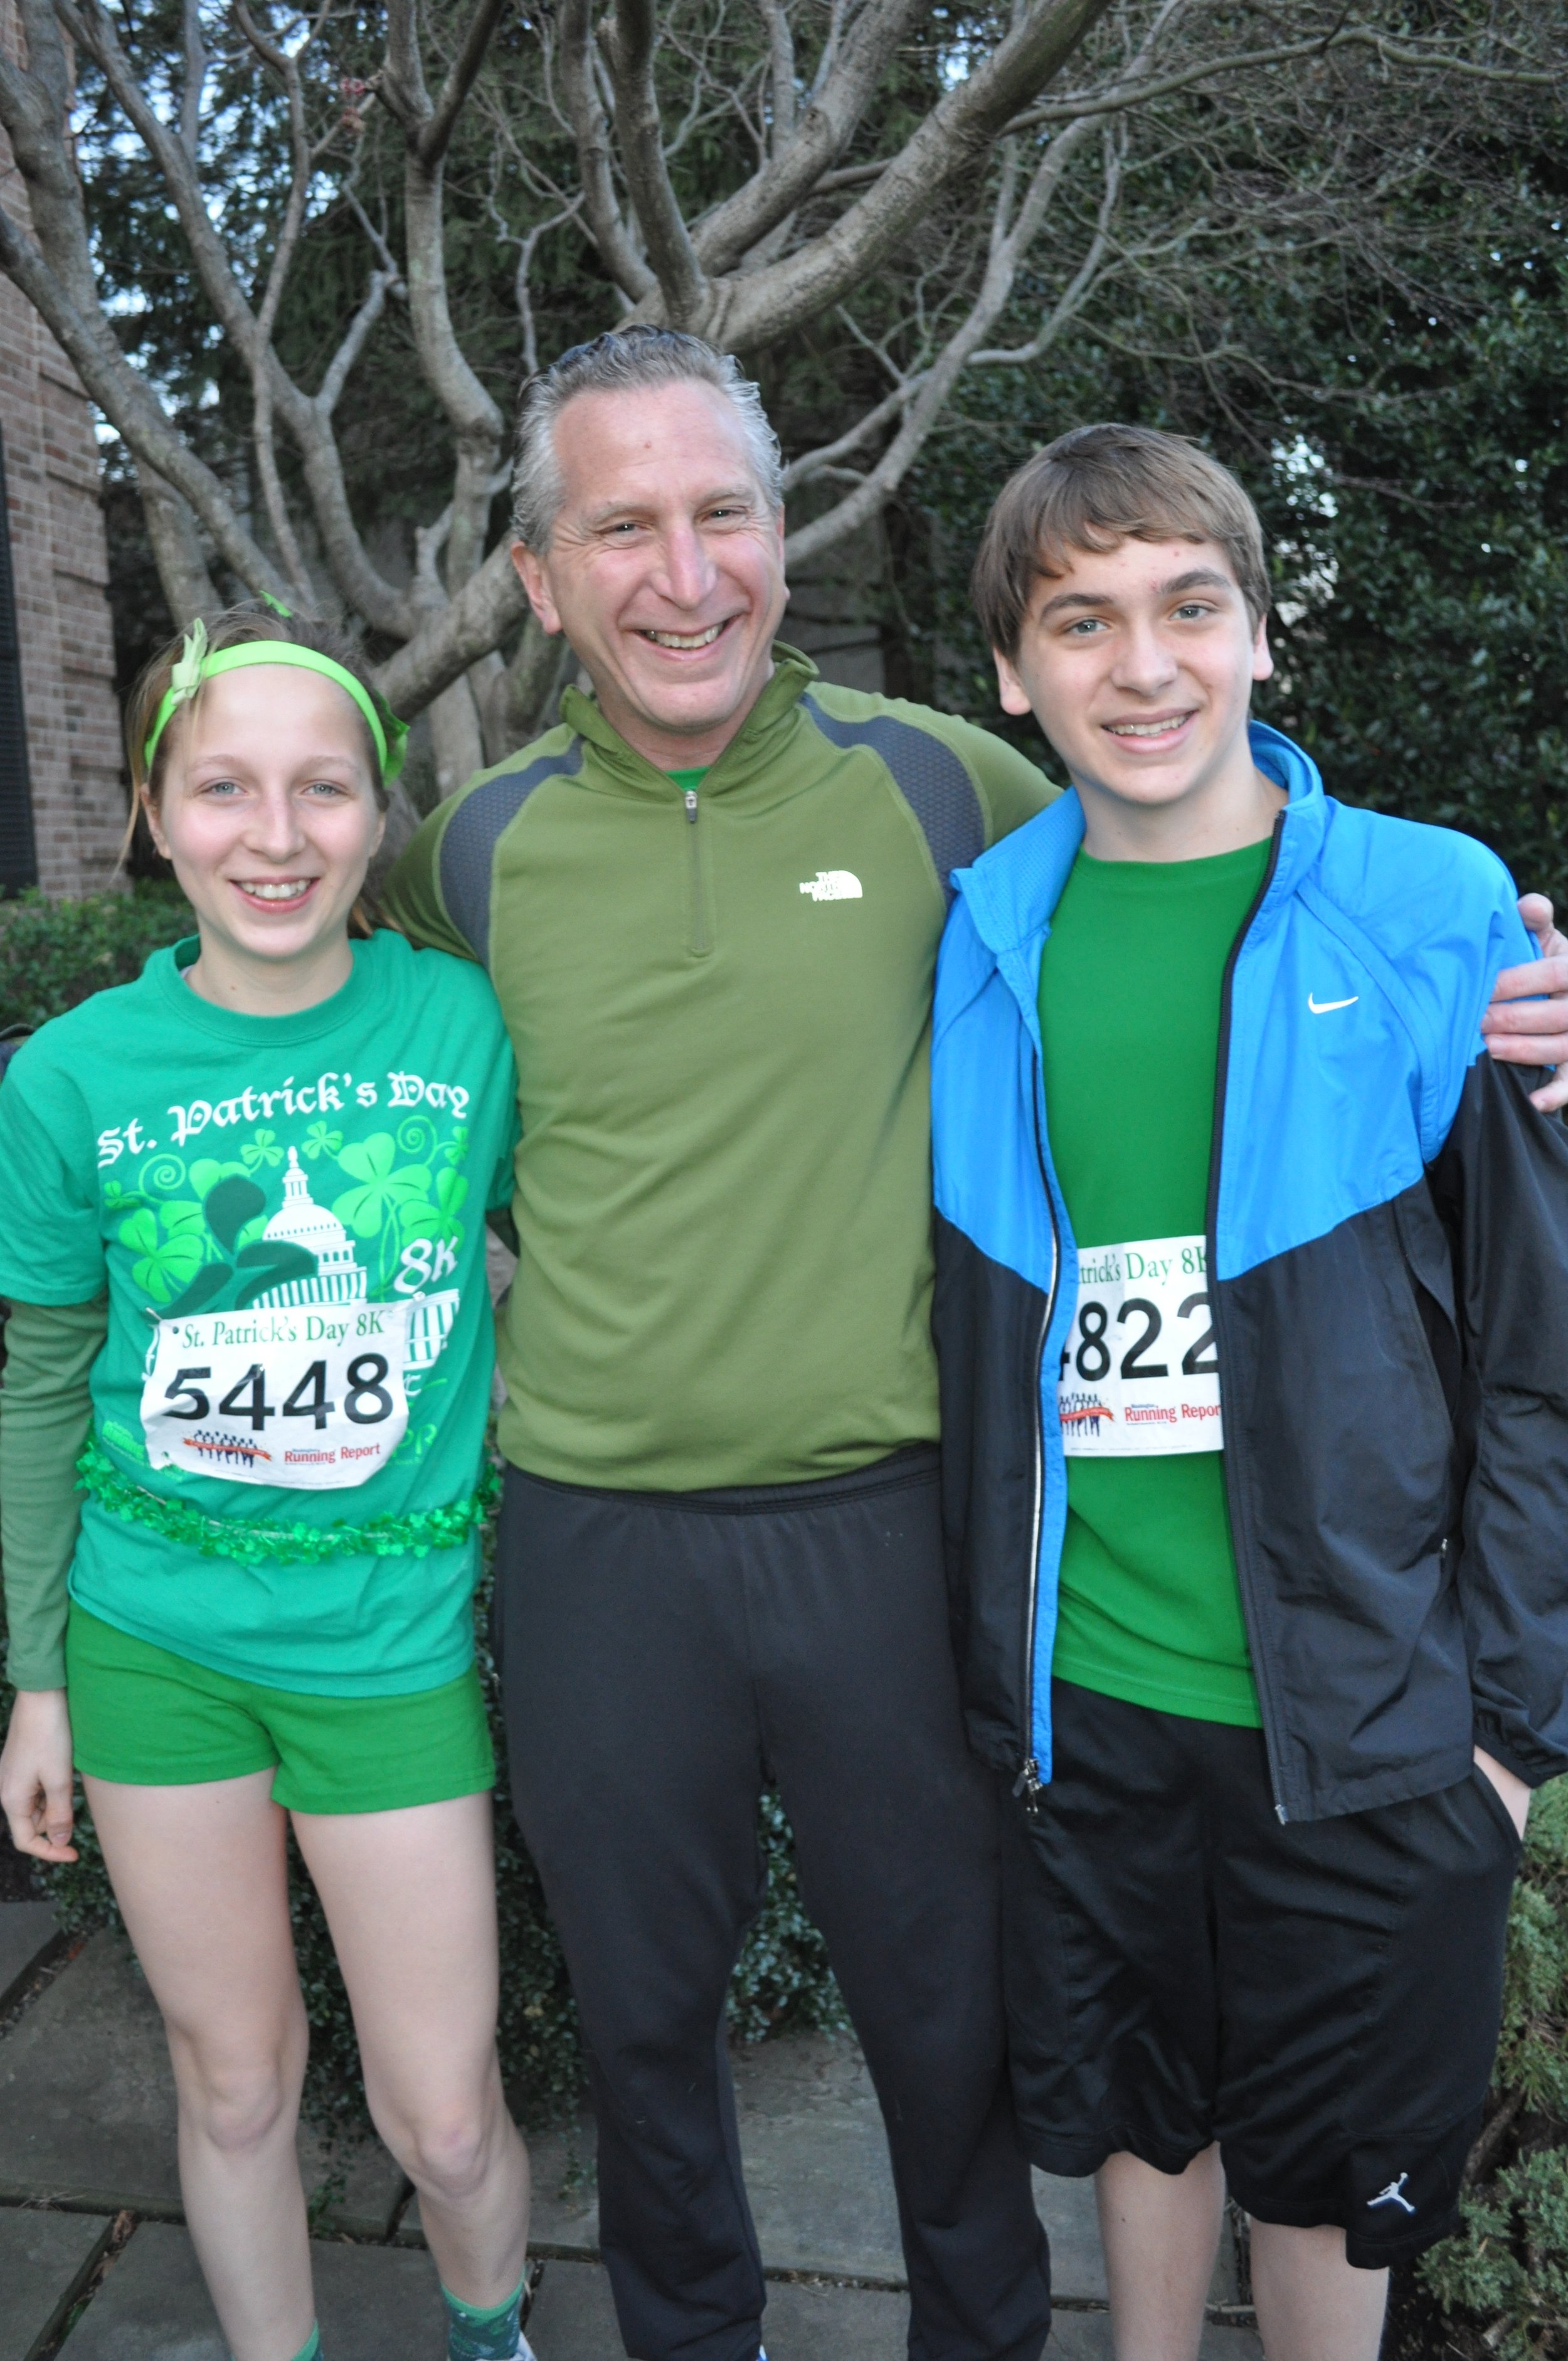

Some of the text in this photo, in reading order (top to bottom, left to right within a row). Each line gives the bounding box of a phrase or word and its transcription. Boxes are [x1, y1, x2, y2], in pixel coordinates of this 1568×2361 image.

[97, 1071, 469, 1168] St. Patrick's Day
[1078, 1253, 1121, 1284] trick's
[1125, 1251, 1173, 1286] Day
[182, 1309, 389, 1349] St. Patrick's Day 8K
[1058, 1291, 1219, 1381] 822
[162, 1352, 393, 1431] 5448
[1125, 1403, 1221, 1423] Running Repor
[284, 1442, 380, 1463] Running Report
